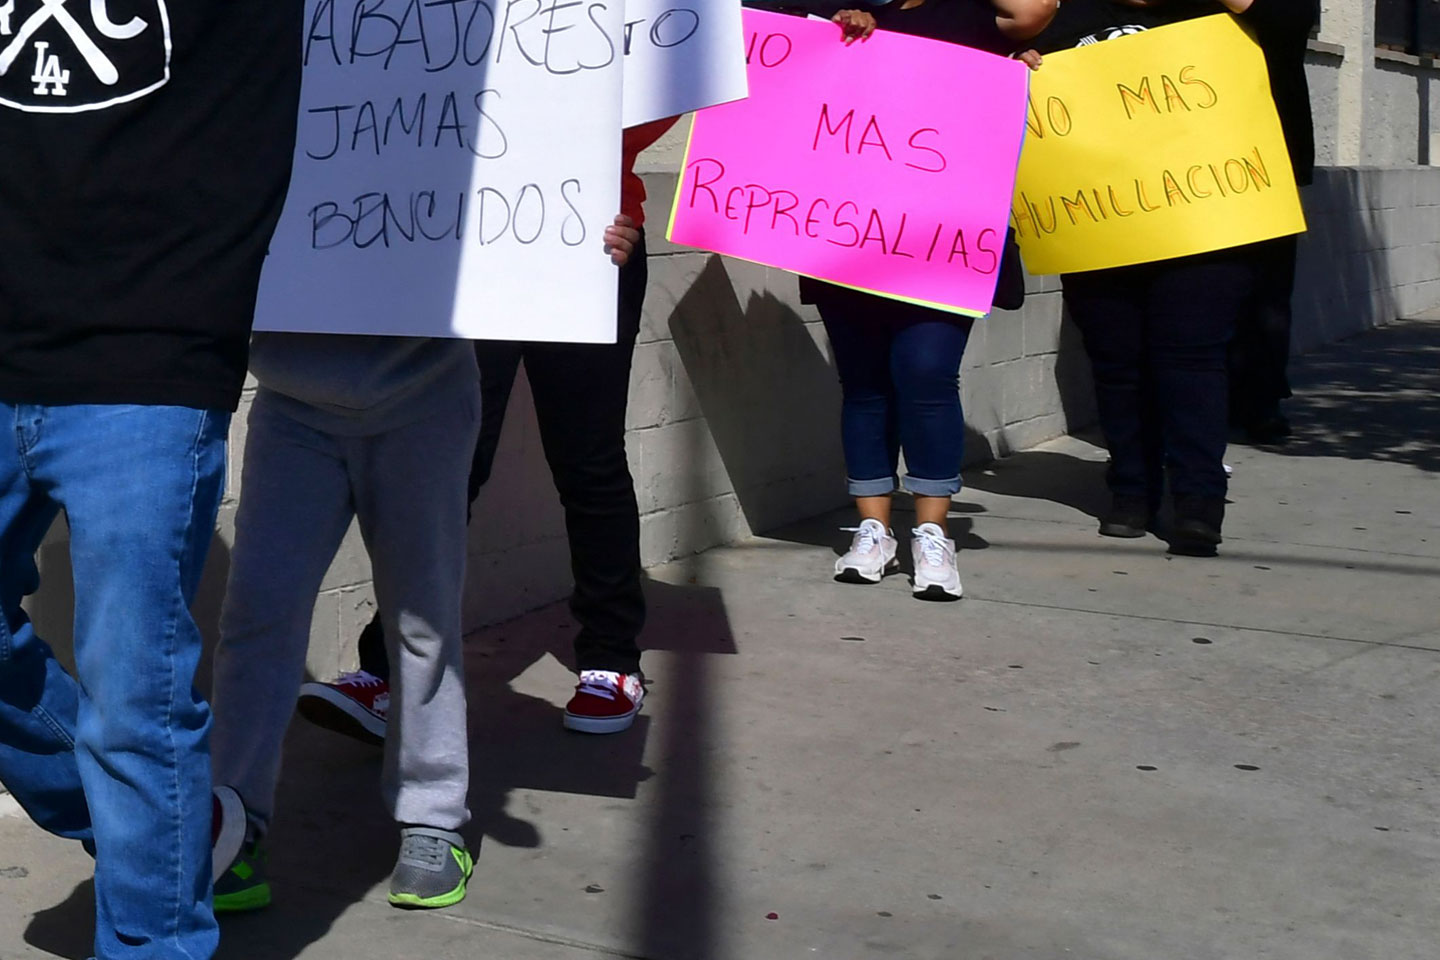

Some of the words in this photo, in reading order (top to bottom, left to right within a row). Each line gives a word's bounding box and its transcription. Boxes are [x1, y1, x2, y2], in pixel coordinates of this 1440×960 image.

[306, 89, 507, 160] JAMAS
[1116, 64, 1218, 121] MAS
[813, 103, 947, 172] MAS
[308, 178, 586, 250] BENCIDOS
[687, 158, 998, 275] REPRESALIAS
[1011, 146, 1272, 240] HUMILLACION
